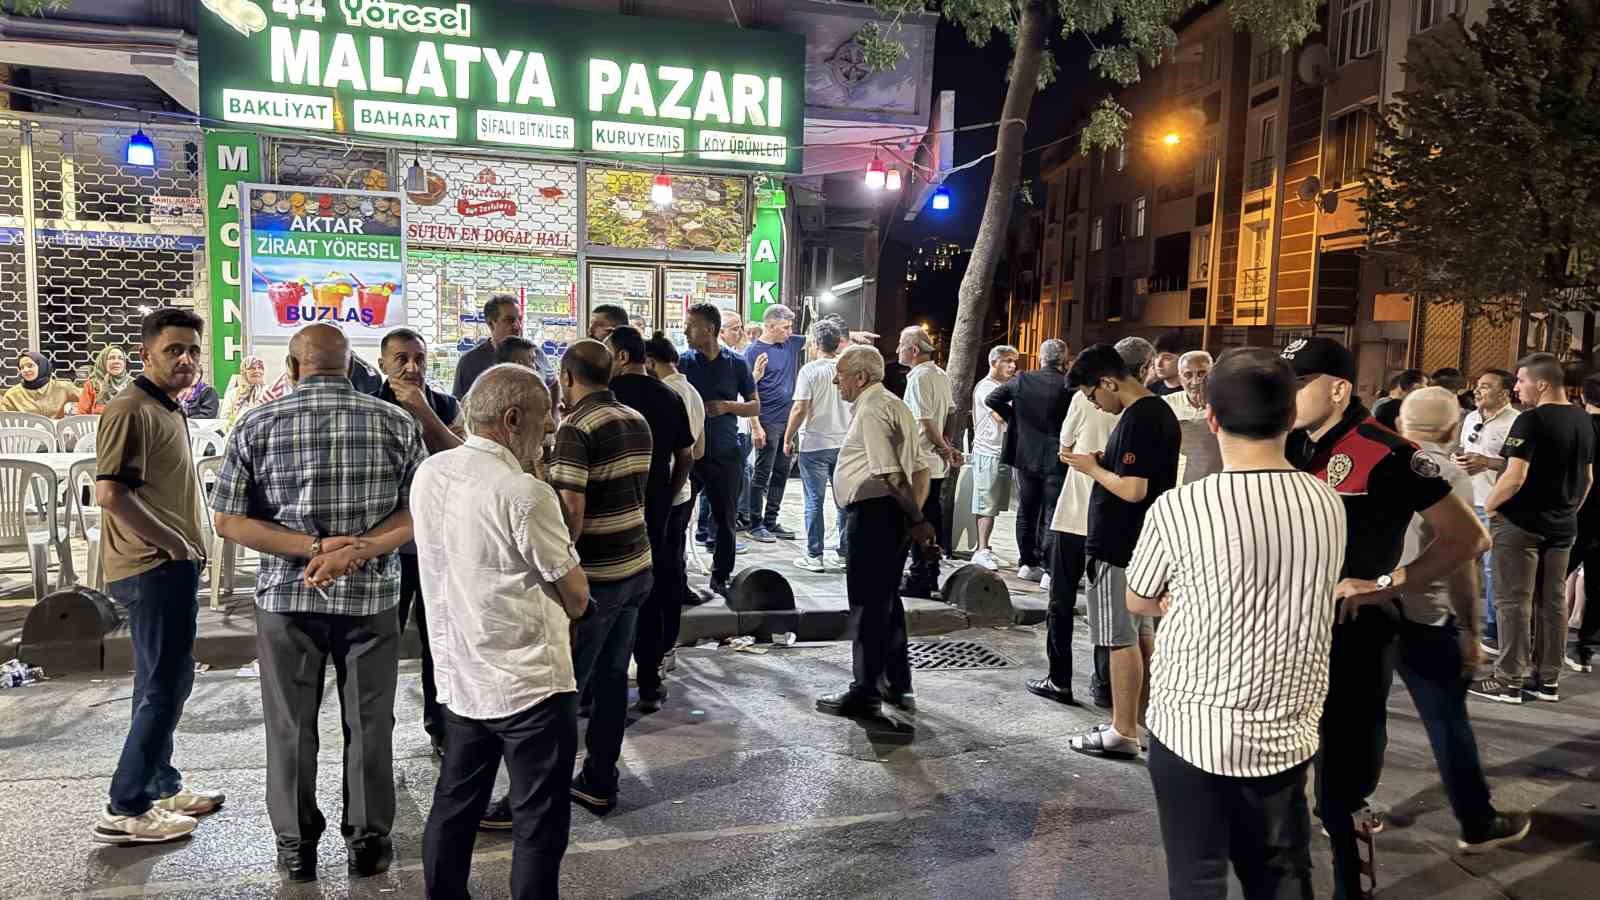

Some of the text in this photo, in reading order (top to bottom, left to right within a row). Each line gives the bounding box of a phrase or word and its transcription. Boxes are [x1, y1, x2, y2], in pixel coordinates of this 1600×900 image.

[270, 26, 783, 127] MALATYA PAZARI
[229, 97, 328, 121] BAKLİYAT
[360, 108, 451, 130] BAHARAT
[290, 215, 365, 234] AKTAR
[257, 233, 400, 259] ZİRAAT YÖRESEL
[286, 306, 374, 326] BUZLAŞ
